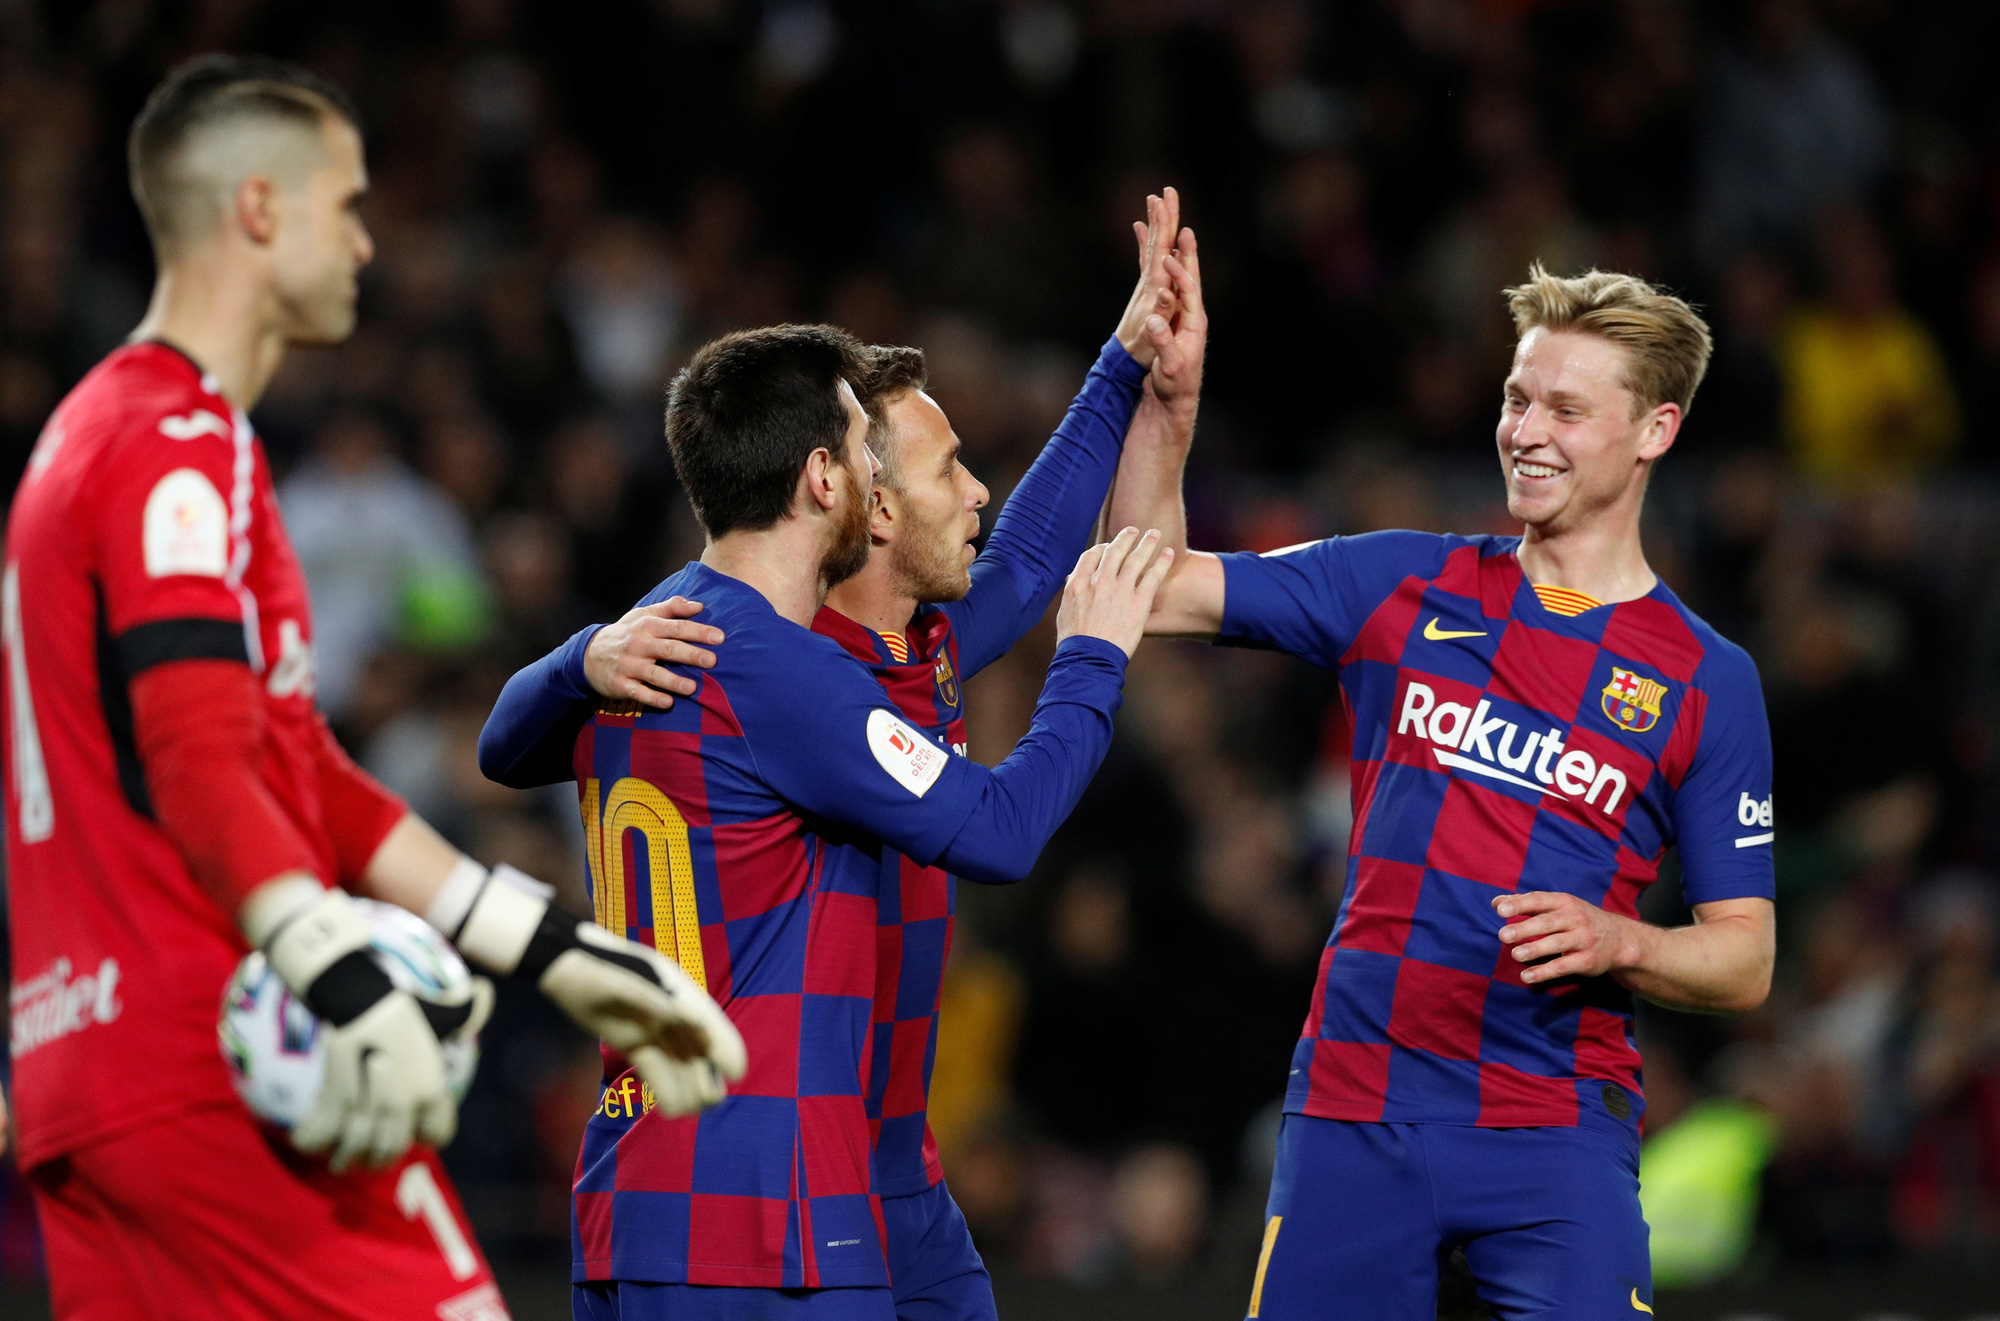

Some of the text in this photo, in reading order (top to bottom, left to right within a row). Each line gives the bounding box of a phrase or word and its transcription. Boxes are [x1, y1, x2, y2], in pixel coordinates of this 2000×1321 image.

[1621, 693, 1644, 708] FCB
[911, 748, 926, 767] COPA
[1397, 681, 1628, 815] Rakuten
[912, 760, 928, 777] DEL
[924, 749, 934, 761] REY
[395, 1161, 478, 1272] 1
